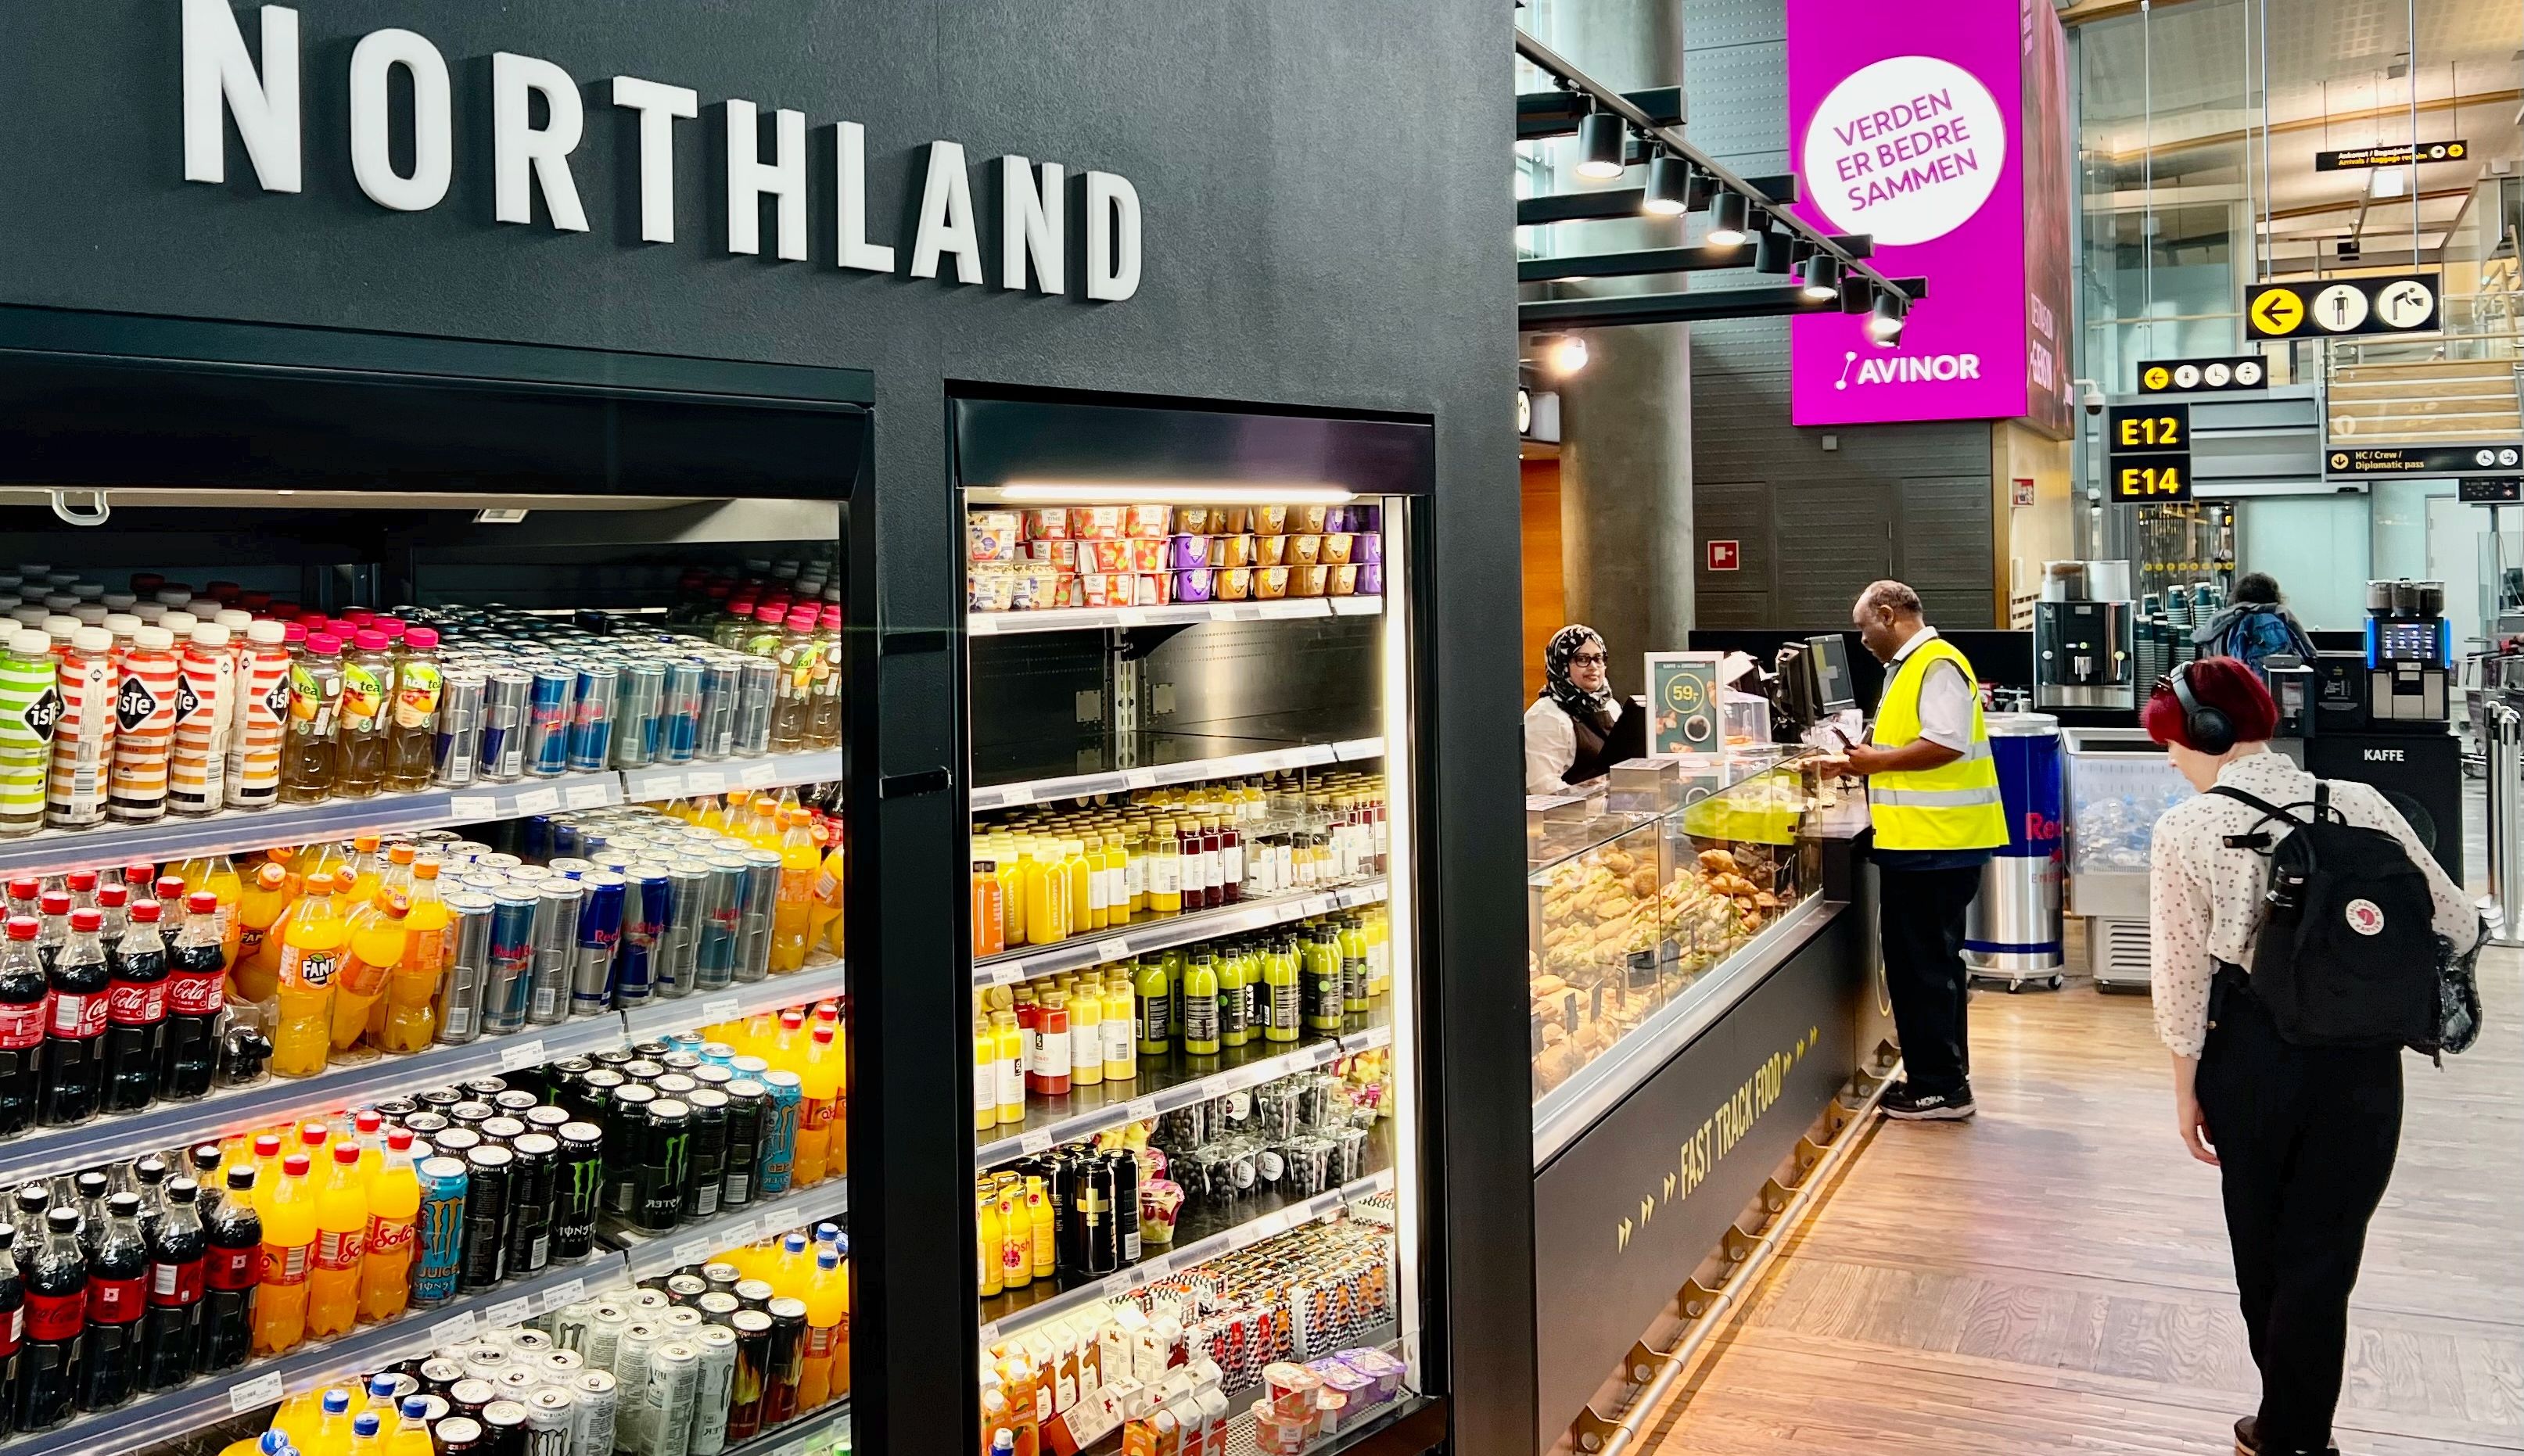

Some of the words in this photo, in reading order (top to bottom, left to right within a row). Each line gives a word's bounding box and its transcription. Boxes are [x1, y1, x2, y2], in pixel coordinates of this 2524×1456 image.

[1833, 88, 1953, 147] VERDEN
[181, 0, 1143, 303] NORTHLAND
[1835, 151, 1875, 182] ER
[1876, 115, 1971, 168] BEDRE
[1847, 147, 1979, 212] SAMMEN
[1857, 353, 1980, 386] AVINOR
[2120, 417, 2178, 446] E12
[2355, 450, 2368, 460] HC
[2374, 450, 2397, 460] Crew
[2355, 461, 2402, 471] Diplomatic
[2404, 461, 2425, 471] pass
[2121, 467, 2179, 496] E14
[299, 682, 318, 696] tea
[361, 680, 380, 693] tea
[2364, 748, 2405, 762] KAFFE
[302, 958, 337, 980] FANT
[1681, 1118, 1712, 1201] FAST
[1714, 1078, 1754, 1161] TRACK
[1755, 1051, 1781, 1120] FOOD
[374, 1224, 415, 1250] Solo
